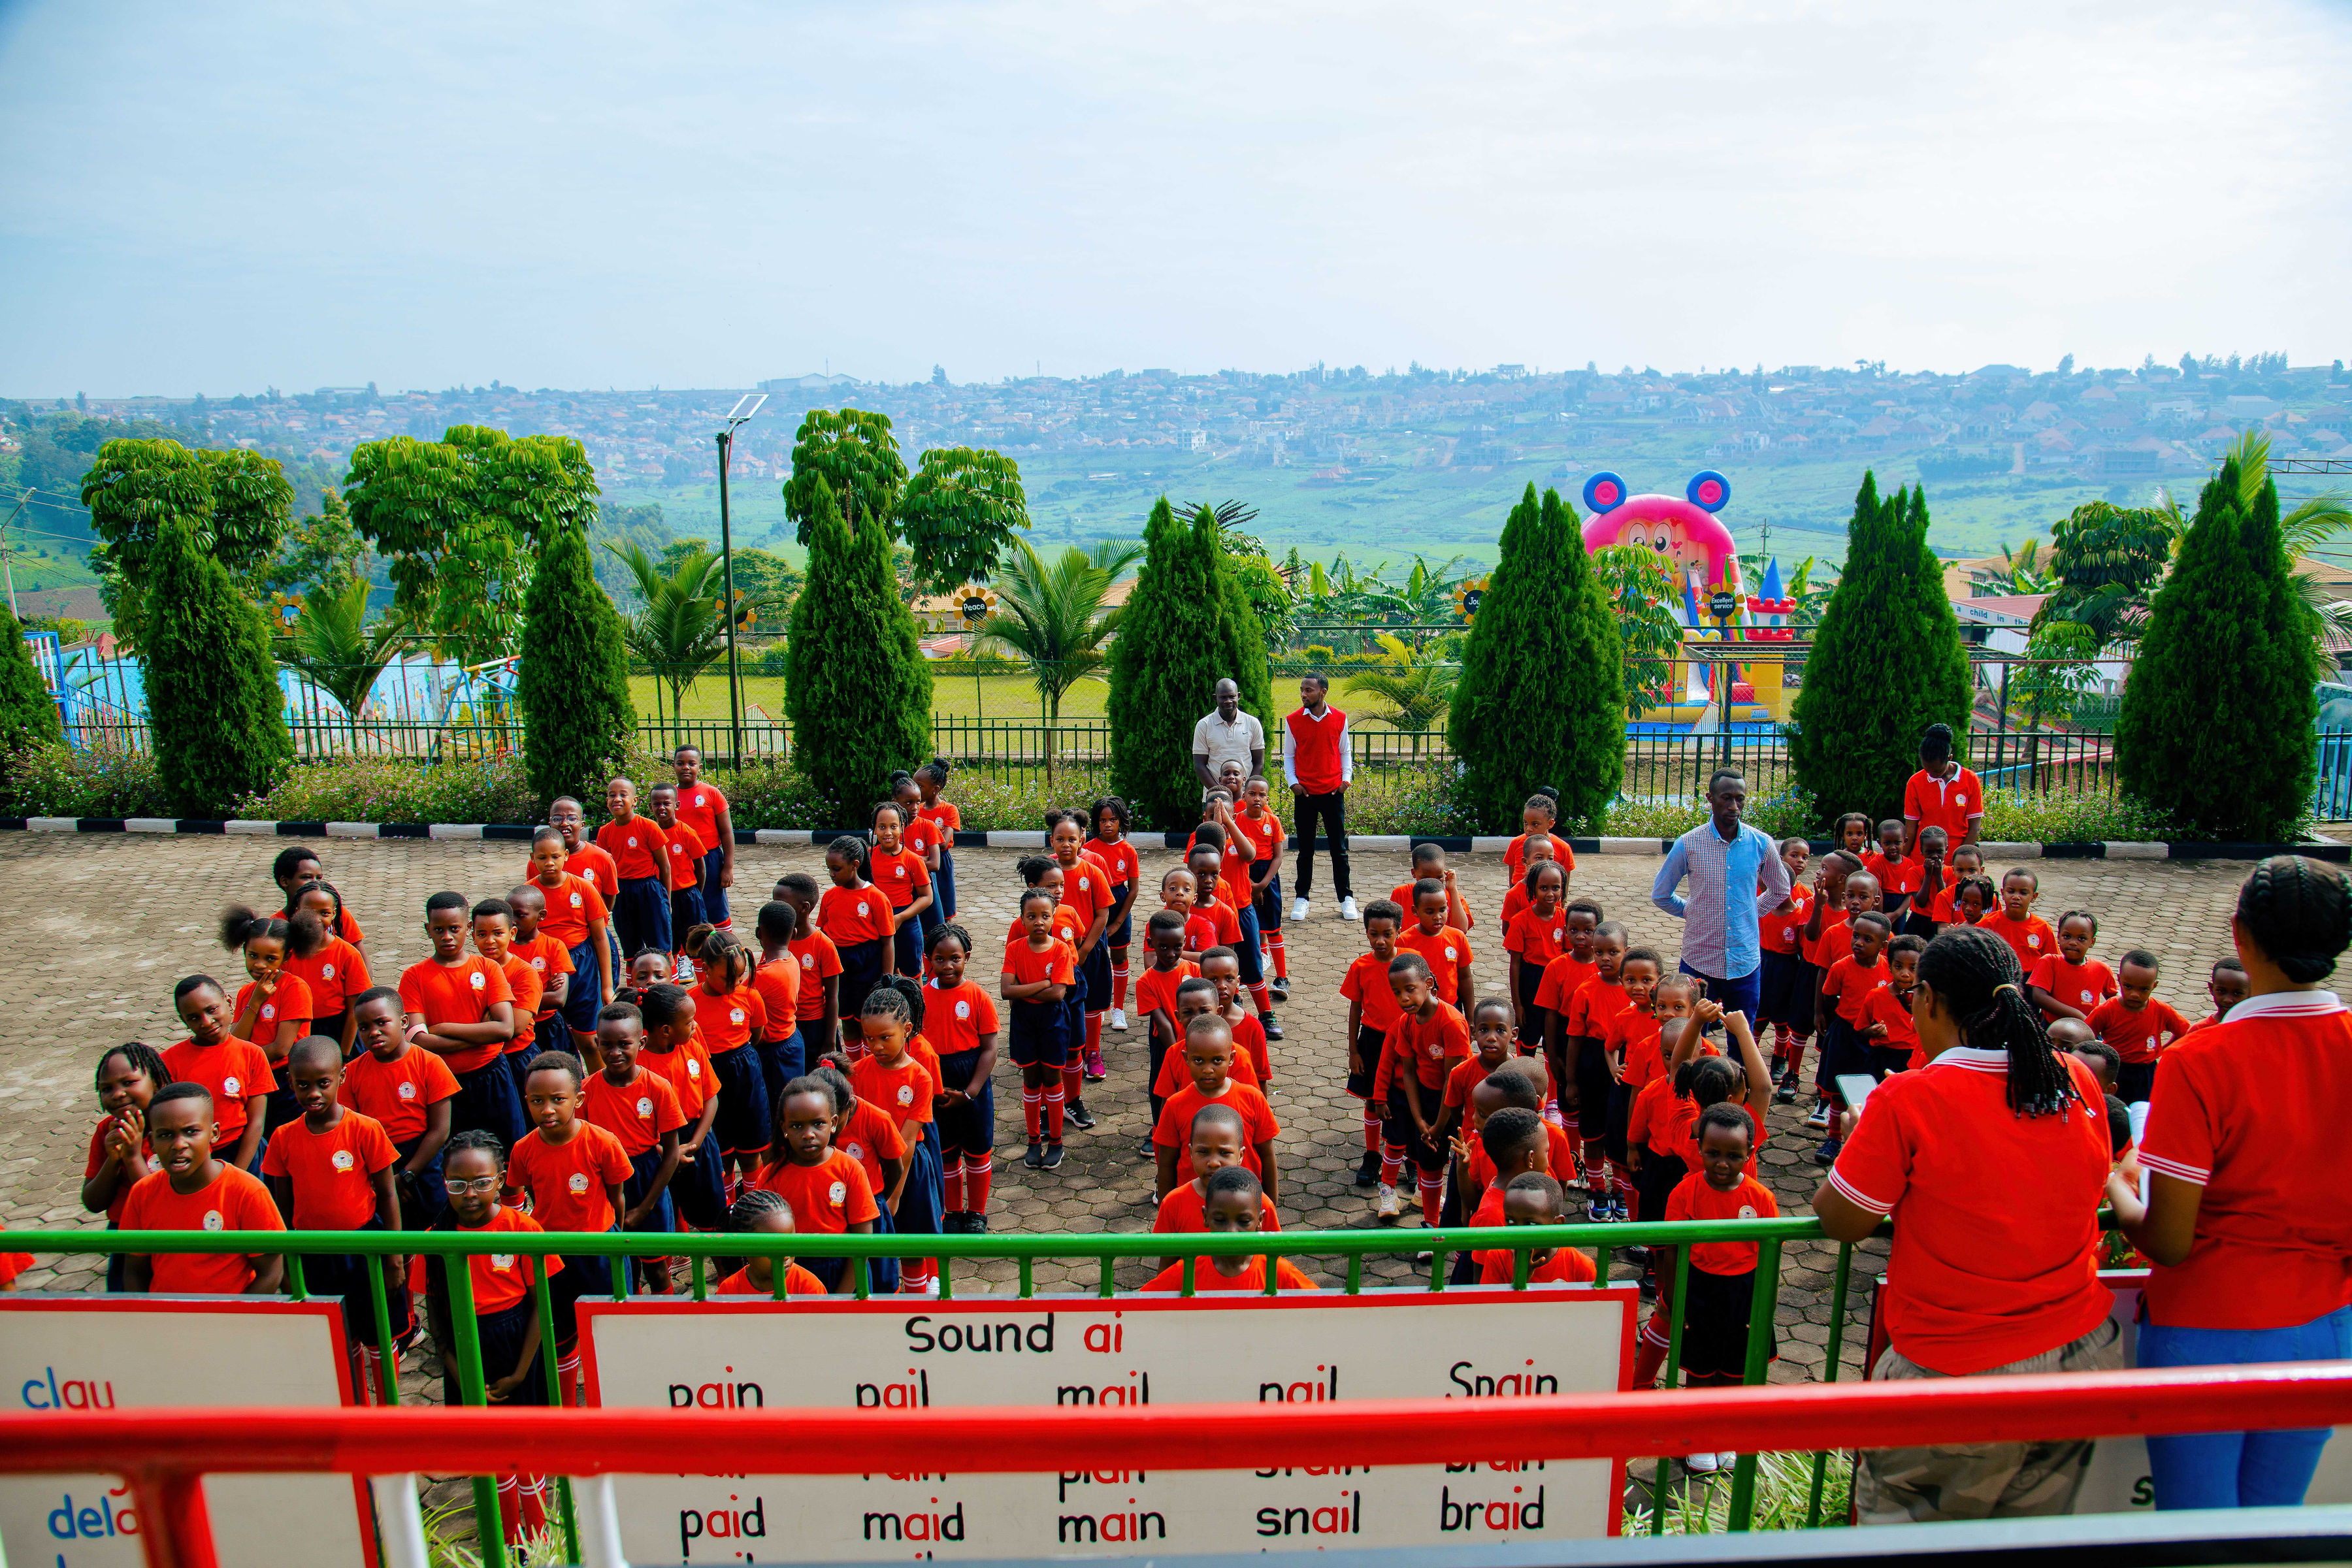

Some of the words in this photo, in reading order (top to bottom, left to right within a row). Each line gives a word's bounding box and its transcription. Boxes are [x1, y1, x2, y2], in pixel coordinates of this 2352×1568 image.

[963, 603, 985, 612] Peace
[1970, 608, 1987, 619] child
[1997, 614, 2004, 623] in
[905, 1311, 1054, 1353] Sound
[1083, 1311, 1123, 1353] ai
[668, 1365, 764, 1409] pain
[856, 1368, 929, 1409] pail
[1057, 1370, 1149, 1407] mail
[1259, 1364, 1337, 1403] nail
[680, 1494, 766, 1558] paid
[864, 1496, 965, 1541] maid
[1058, 1497, 1167, 1543] main
[1256, 1490, 1360, 1537] snail
[1440, 1484, 1544, 1531] braid
